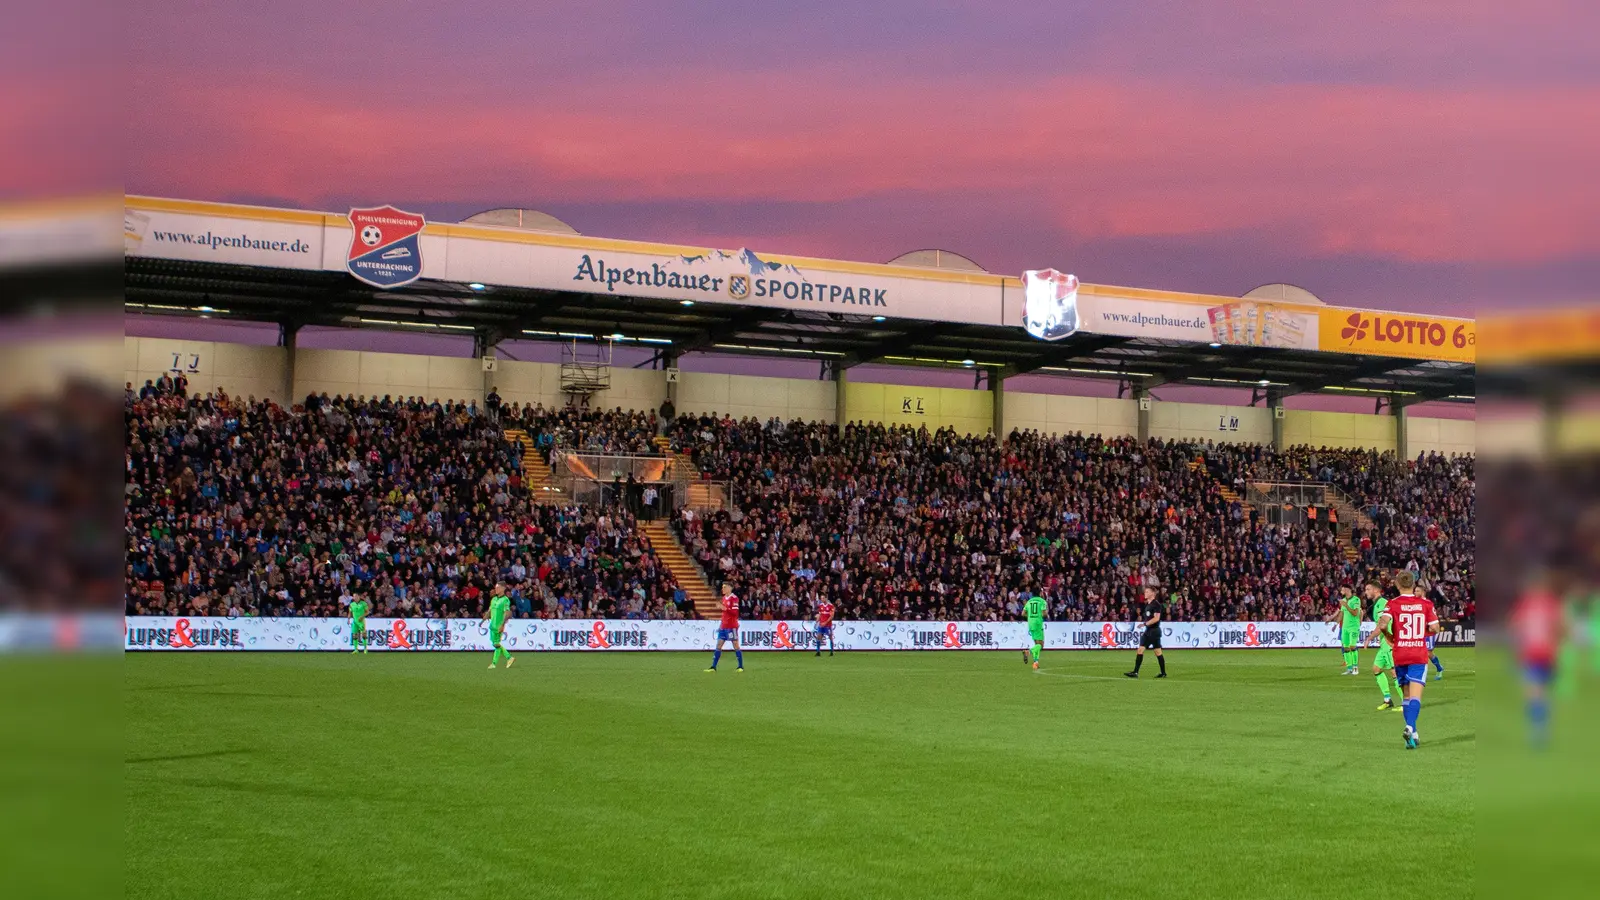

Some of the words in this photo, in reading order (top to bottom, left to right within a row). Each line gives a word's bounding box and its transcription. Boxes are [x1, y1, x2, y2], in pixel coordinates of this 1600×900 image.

[357, 215, 418, 227] SPIELVEREINIGUNG
[153, 228, 310, 254] www.alpenbauer.de
[356, 261, 414, 272] UNTERHACHING
[573, 254, 723, 292] Alpenbauer
[755, 279, 888, 307] SPORTPARK
[1103, 311, 1206, 329] www.alpenbauer.de
[1374, 317, 1446, 347] LOTTO
[1452, 325, 1467, 348] 6
[189, 356, 199, 369] J
[670, 373, 676, 381] K
[903, 399, 912, 409] K
[917, 400, 924, 410] L
[1220, 418, 1226, 428] L
[1230, 418, 1238, 428] M
[1030, 602, 1038, 615] 10
[1399, 613, 1425, 639] 30
